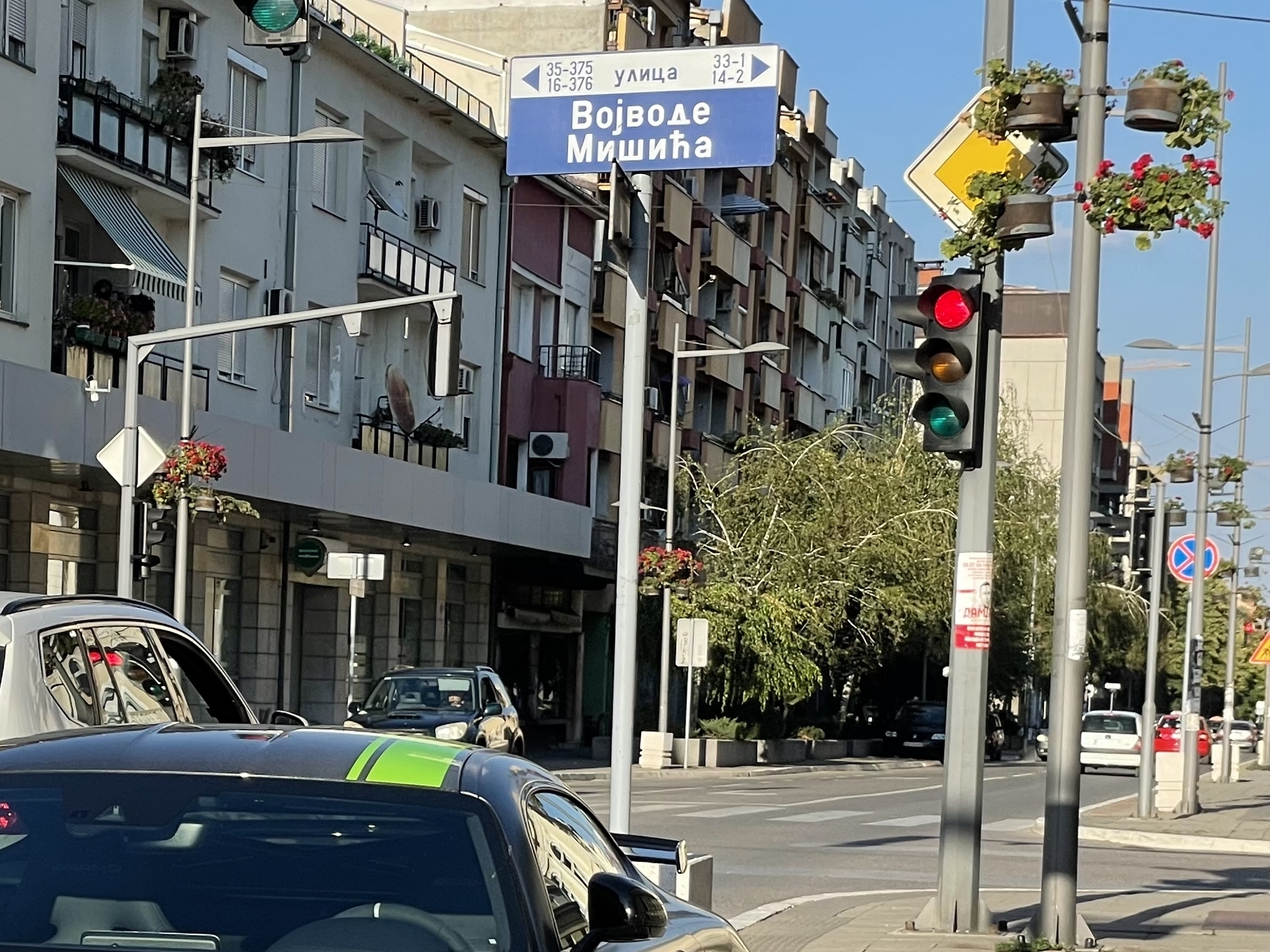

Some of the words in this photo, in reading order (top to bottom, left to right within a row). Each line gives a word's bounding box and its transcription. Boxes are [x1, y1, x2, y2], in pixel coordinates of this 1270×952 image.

[546, 60, 594, 77] 35-375
[713, 53, 746, 69] 33-1
[546, 76, 594, 93] 16-376
[614, 65, 678, 87] улица
[711, 68, 745, 85] 14-2
[571, 98, 711, 135] Војводе
[567, 130, 712, 163] Мишића
